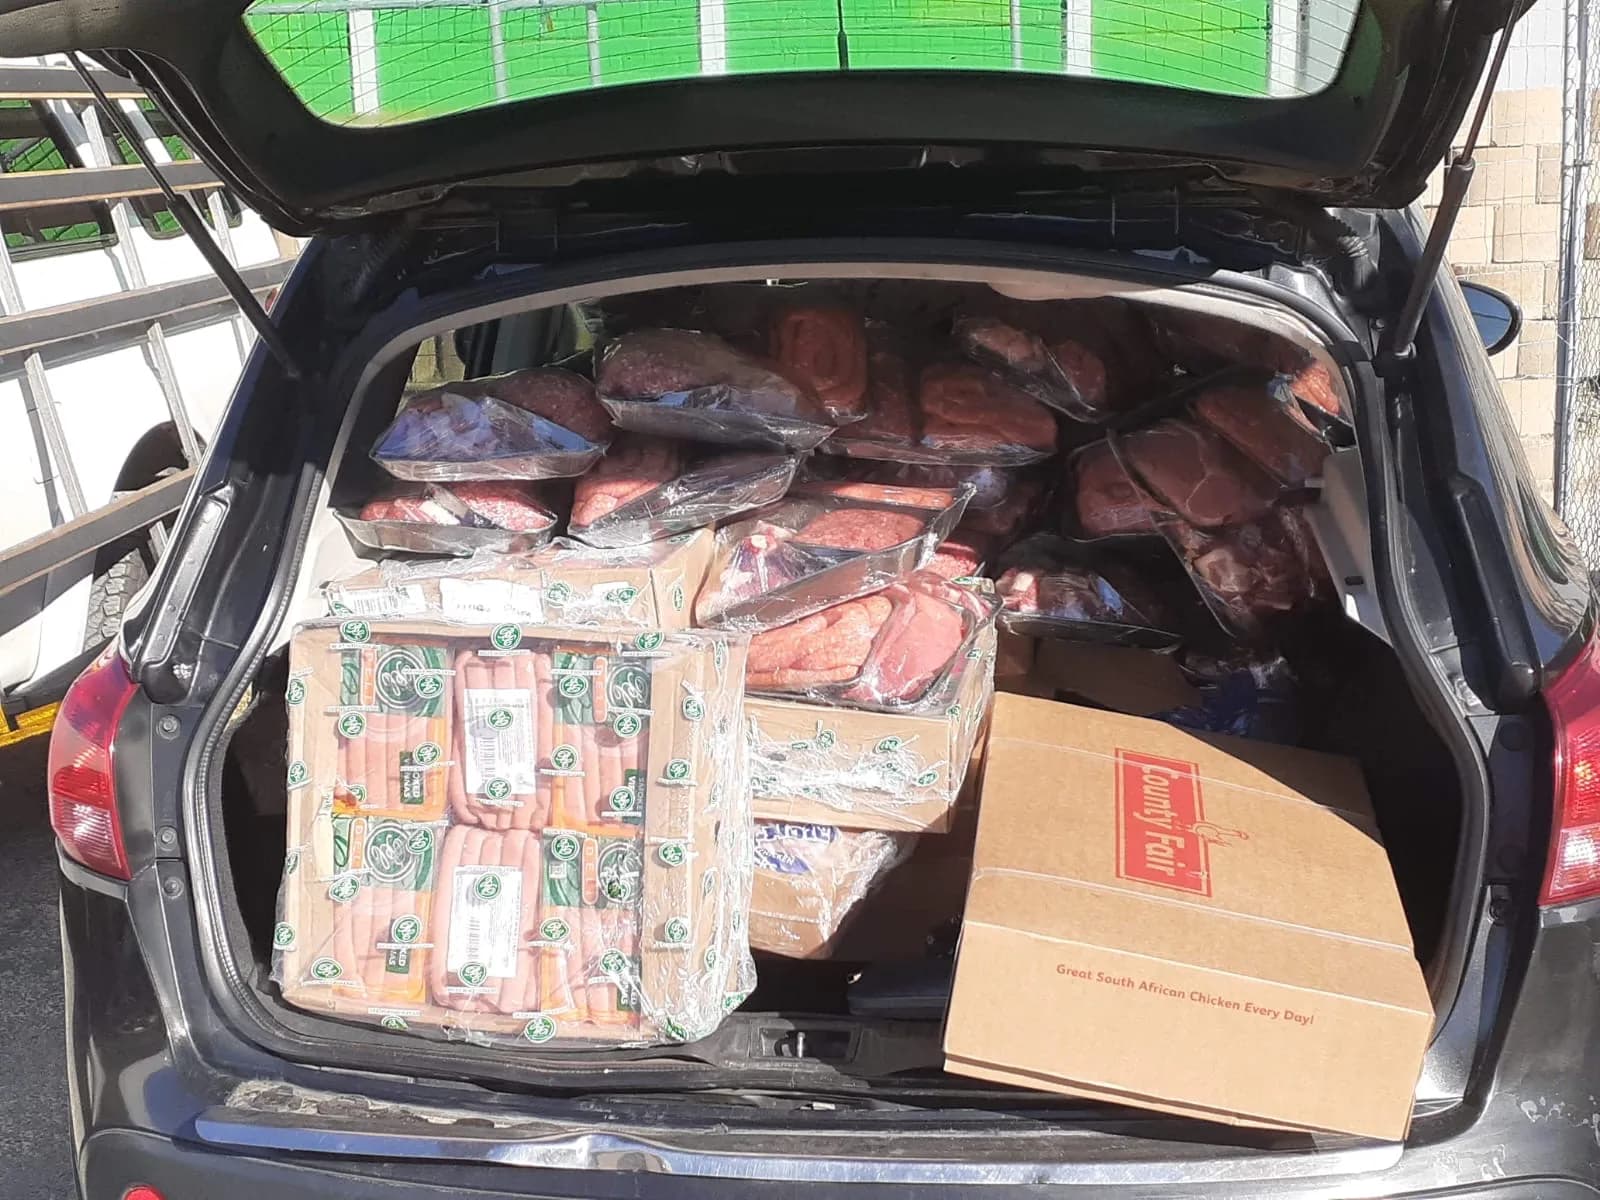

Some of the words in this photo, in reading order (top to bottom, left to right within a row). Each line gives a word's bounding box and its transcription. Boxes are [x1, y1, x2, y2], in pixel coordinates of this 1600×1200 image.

[1145, 831, 1187, 877] Fair
[1056, 963, 1093, 981] Great
[1096, 972, 1136, 990] South
[1138, 980, 1186, 1000] African
[1190, 991, 1241, 1011] Chicken
[1243, 1002, 1280, 1020] Every
[1284, 1009, 1315, 1026] Day!
